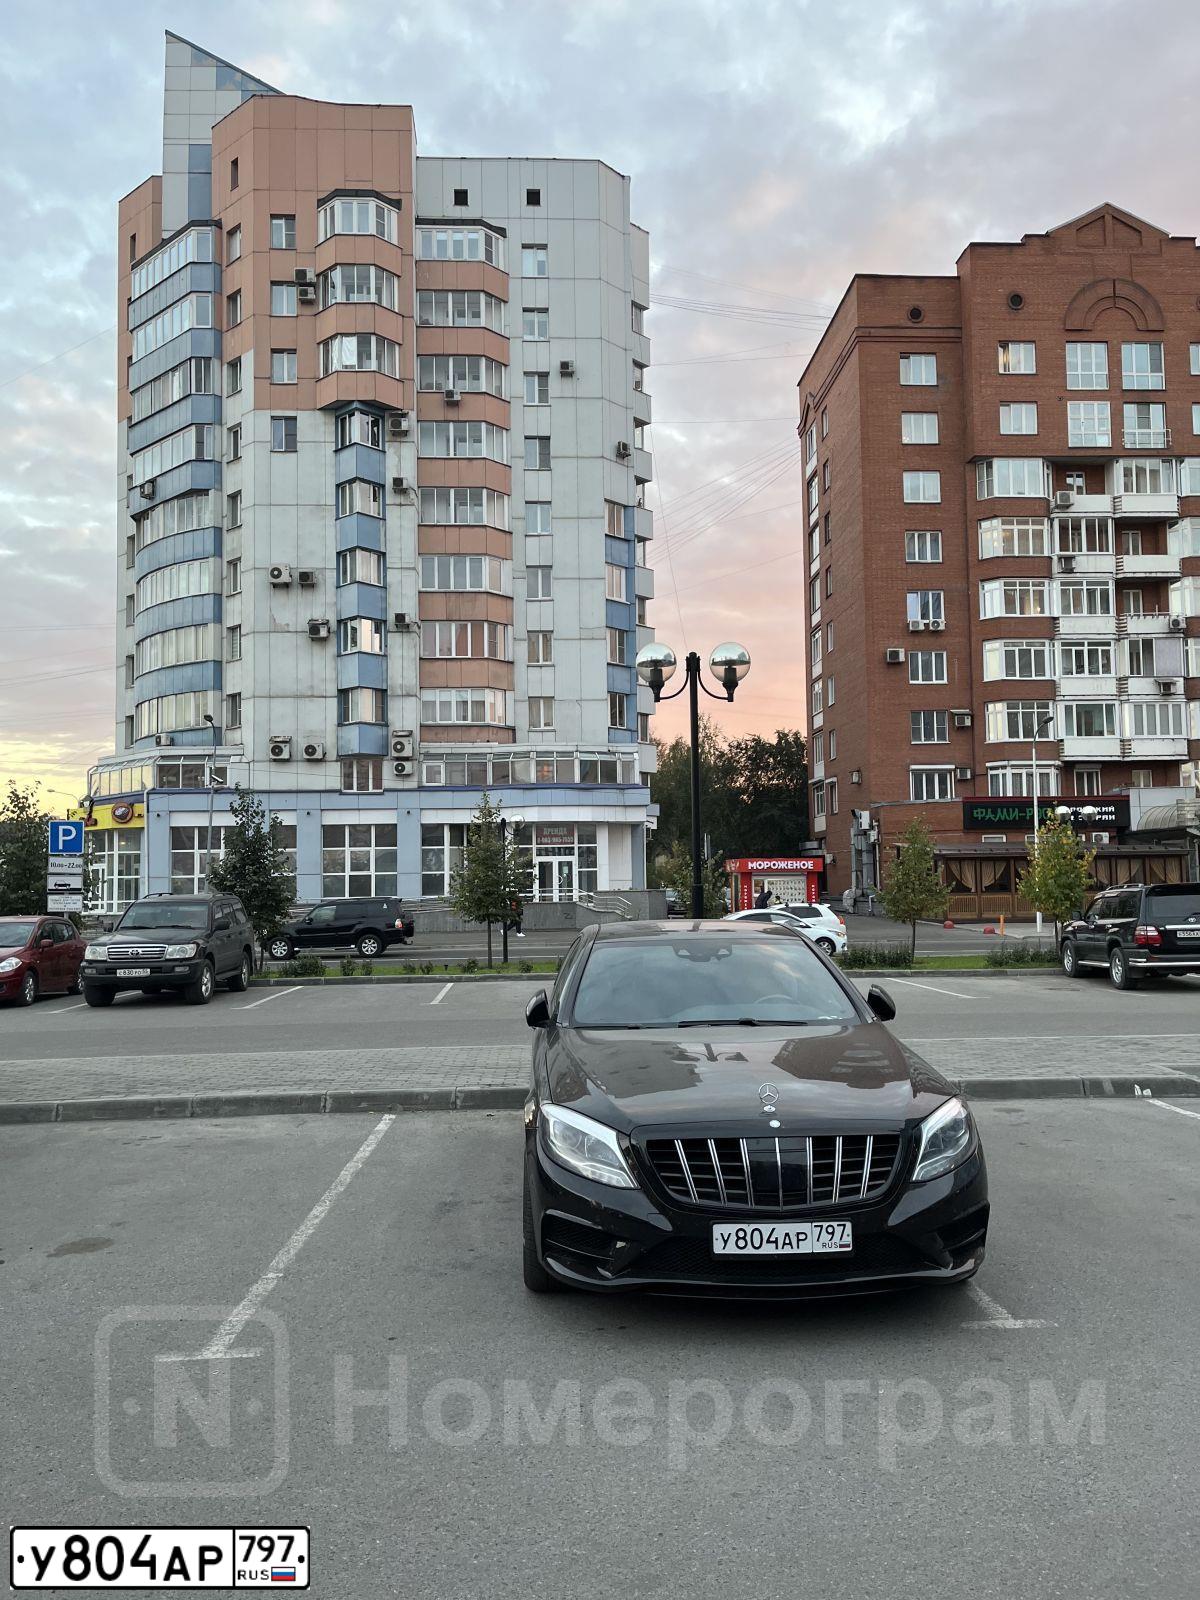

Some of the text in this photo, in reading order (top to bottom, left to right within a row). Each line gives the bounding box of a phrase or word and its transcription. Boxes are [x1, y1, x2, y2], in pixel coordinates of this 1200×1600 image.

[973, 806, 1053, 822] ФАМИ-РОС
[58, 825, 77, 850] P
[543, 827, 567, 835] АРЕНДА
[748, 861, 814, 870] МОРОЖЕНОЕ
[720, 1223, 847, 1250] У804АР 797
